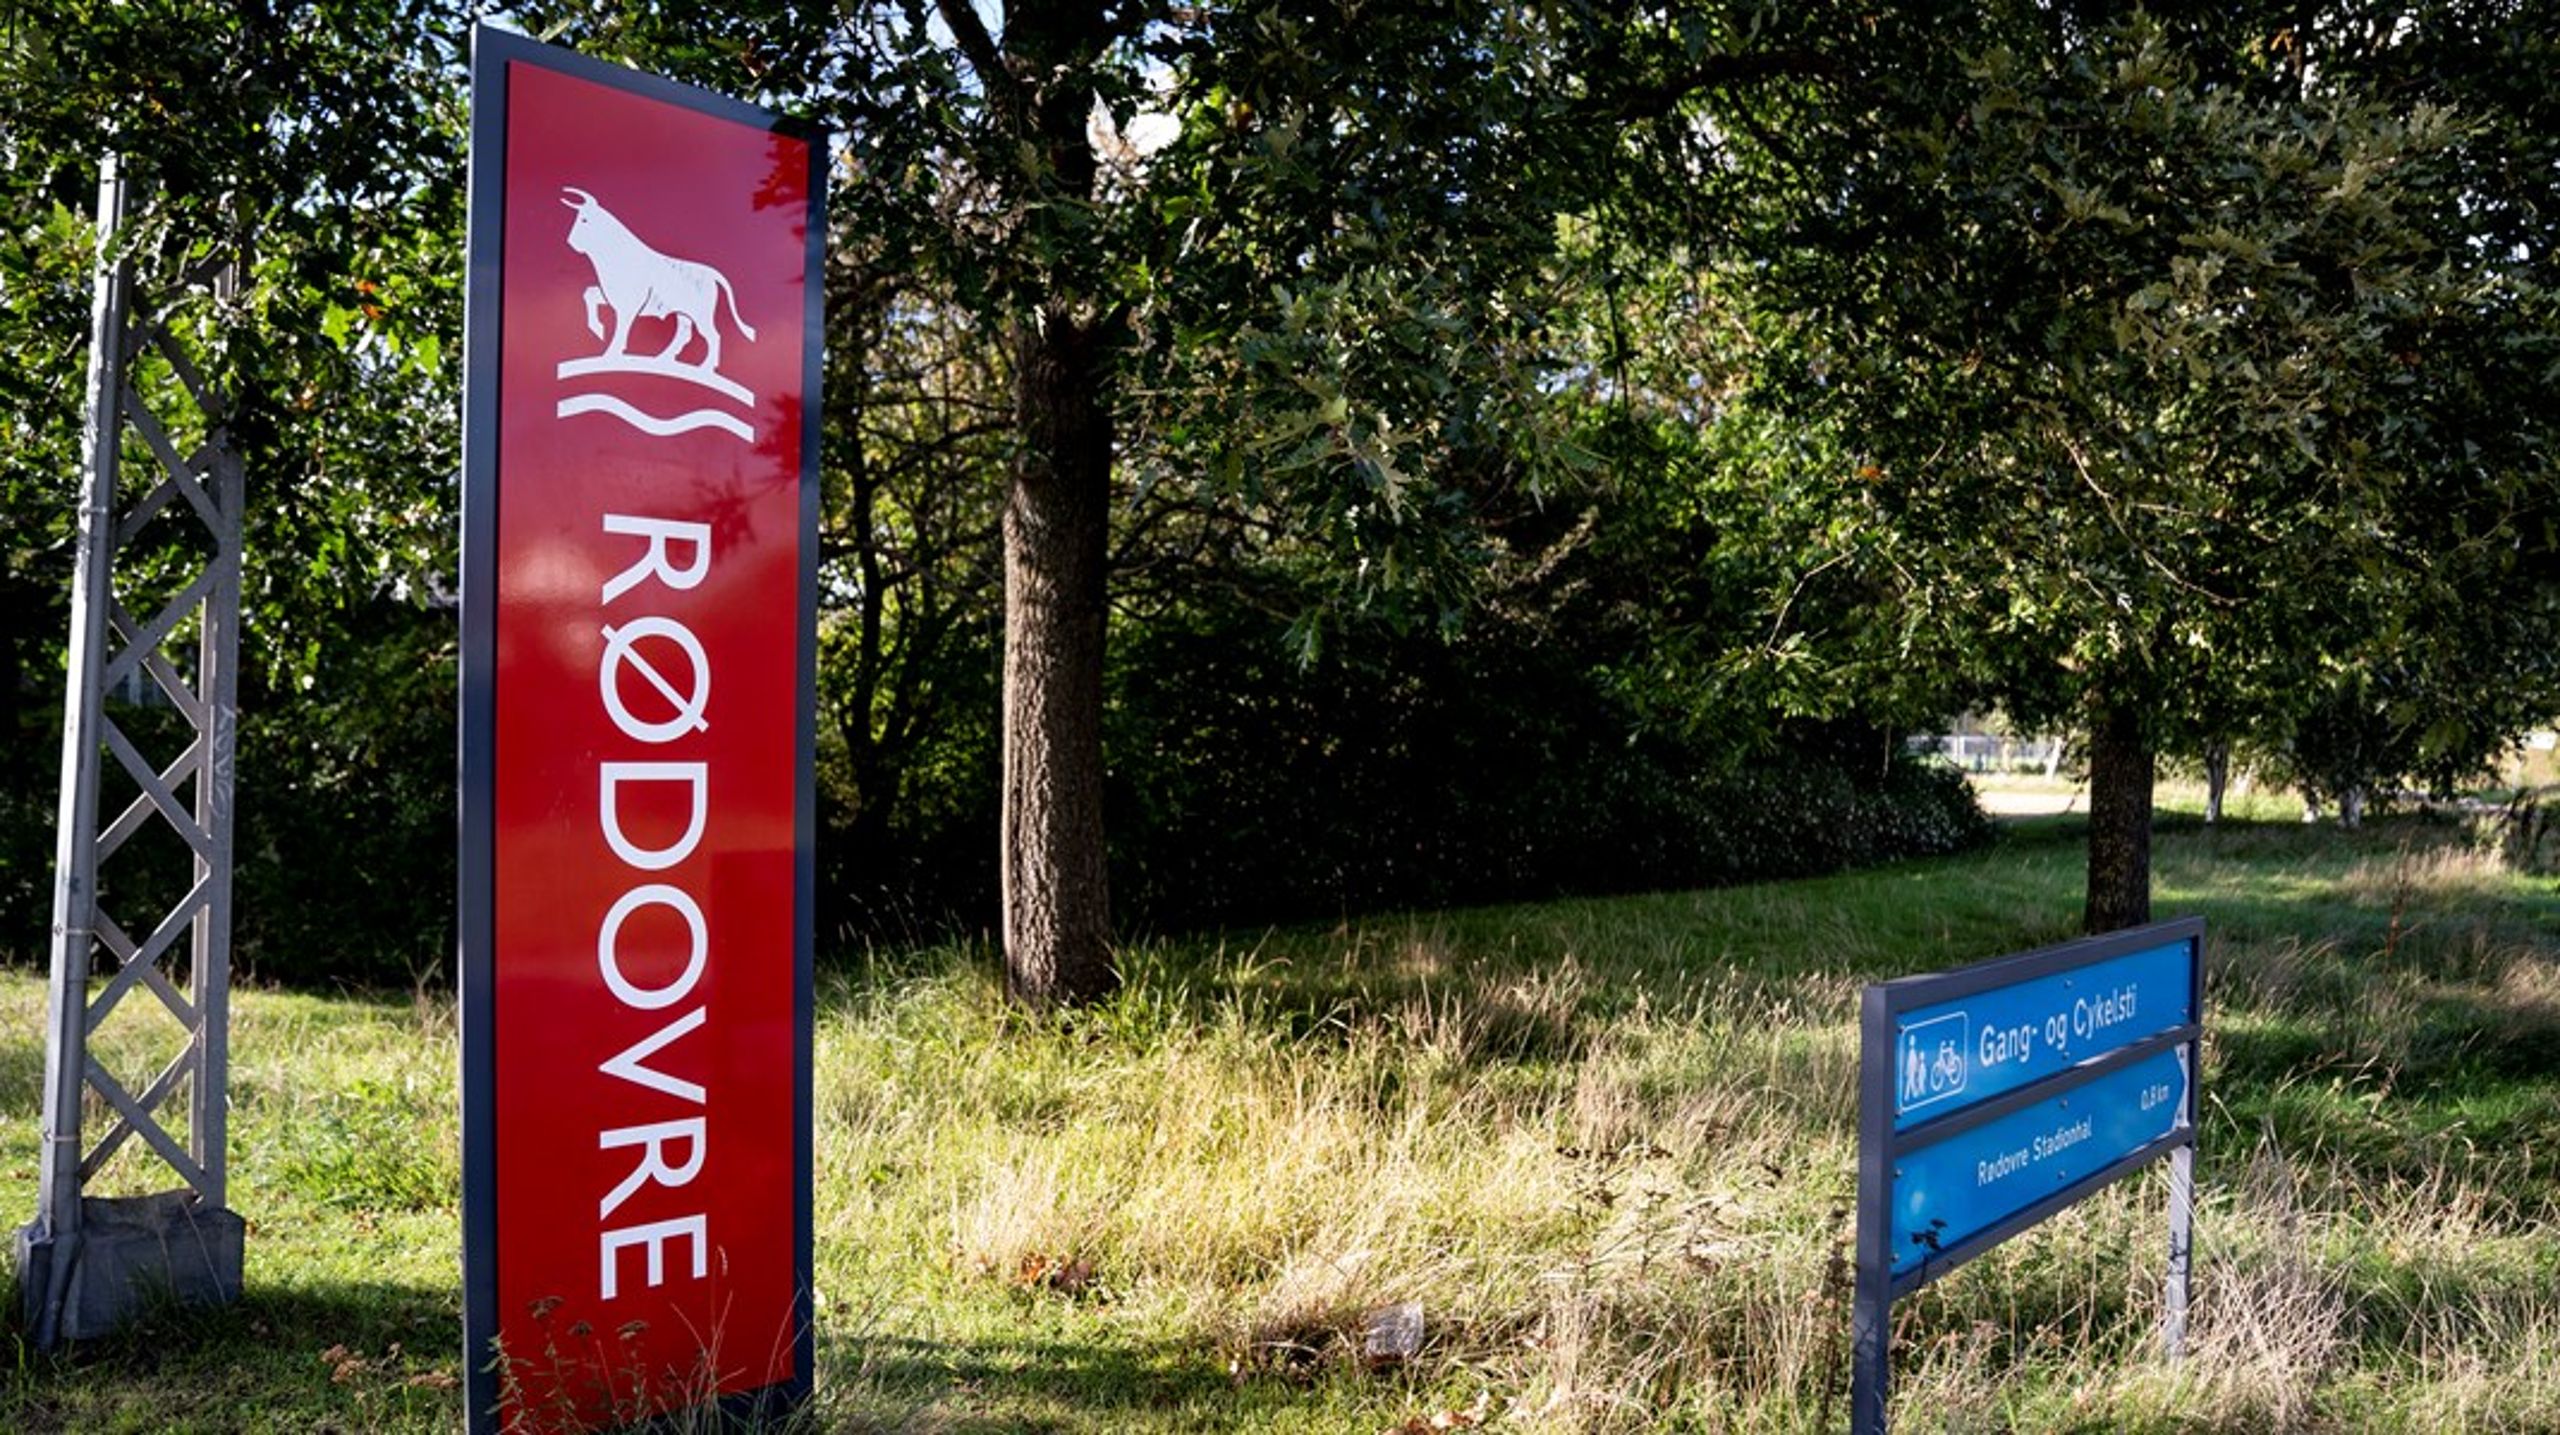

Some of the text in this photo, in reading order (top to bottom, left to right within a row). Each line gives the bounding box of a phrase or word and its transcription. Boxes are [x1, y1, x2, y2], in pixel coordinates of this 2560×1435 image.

[598, 512, 712, 1301] RØDOVRE
[1980, 983, 2137, 1067] Gang- og Cykelsti
[1978, 1114, 2092, 1186] Rødovre Stadionhal
